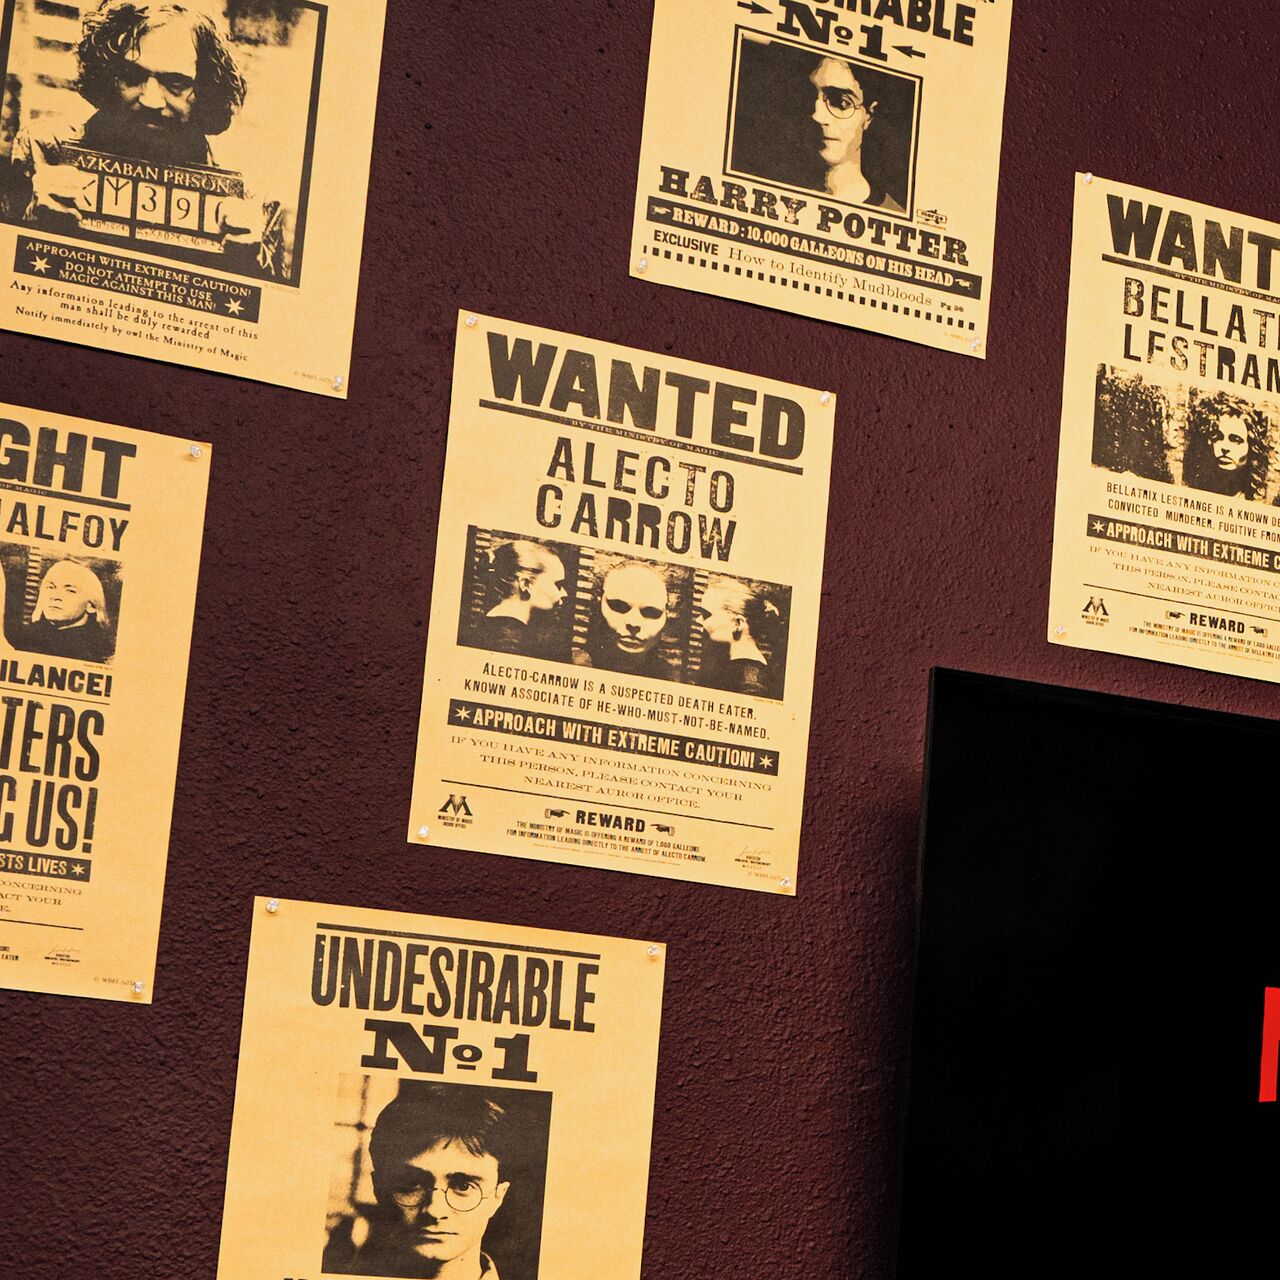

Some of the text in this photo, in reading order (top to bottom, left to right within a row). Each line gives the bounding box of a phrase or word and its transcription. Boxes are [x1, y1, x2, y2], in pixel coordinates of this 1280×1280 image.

[76, 155, 232, 194] AZKABAN PRISON
[658, 165, 969, 267] HARRY POTTER
[26, 242, 252, 297] APPROACH WITH EXTREME CAUTION!
[65, 261, 213, 302] DO NOT ATTEMPT TO USE
[653, 229, 932, 305] EXCLUSIVE How to Identify Mudbloods
[746, 225, 789, 248] 10,000
[789, 236, 865, 266] GALLEONS
[865, 254, 887, 272] ON
[887, 259, 913, 278] HIS
[914, 265, 954, 287] HEAD
[59, 269, 217, 311] MAGIC AGAINST THIS MAN!
[486, 331, 806, 461] WANTED
[546, 436, 735, 514] ALECTO
[535, 483, 737, 563] CARROW
[1106, 521, 1173, 549] APPROACH
[1176, 534, 1209, 556] WITH
[1212, 542, 1270, 568] EXTREME
[1189, 612, 1245, 634] REWARD
[583, 679, 594, 692] IS
[598, 683, 606, 695] A
[610, 684, 674, 706] SUSPECTED
[678, 695, 715, 713] DEATH
[718, 703, 757, 720] EATER.
[473, 708, 756, 769] APPROACH WITH EXTREME CAUTION!
[25, 779, 99, 854] US!
[575, 809, 646, 833] REWARD
[27, 856, 68, 876] LIVES
[311, 933, 600, 1034] UNDESIRABLE
